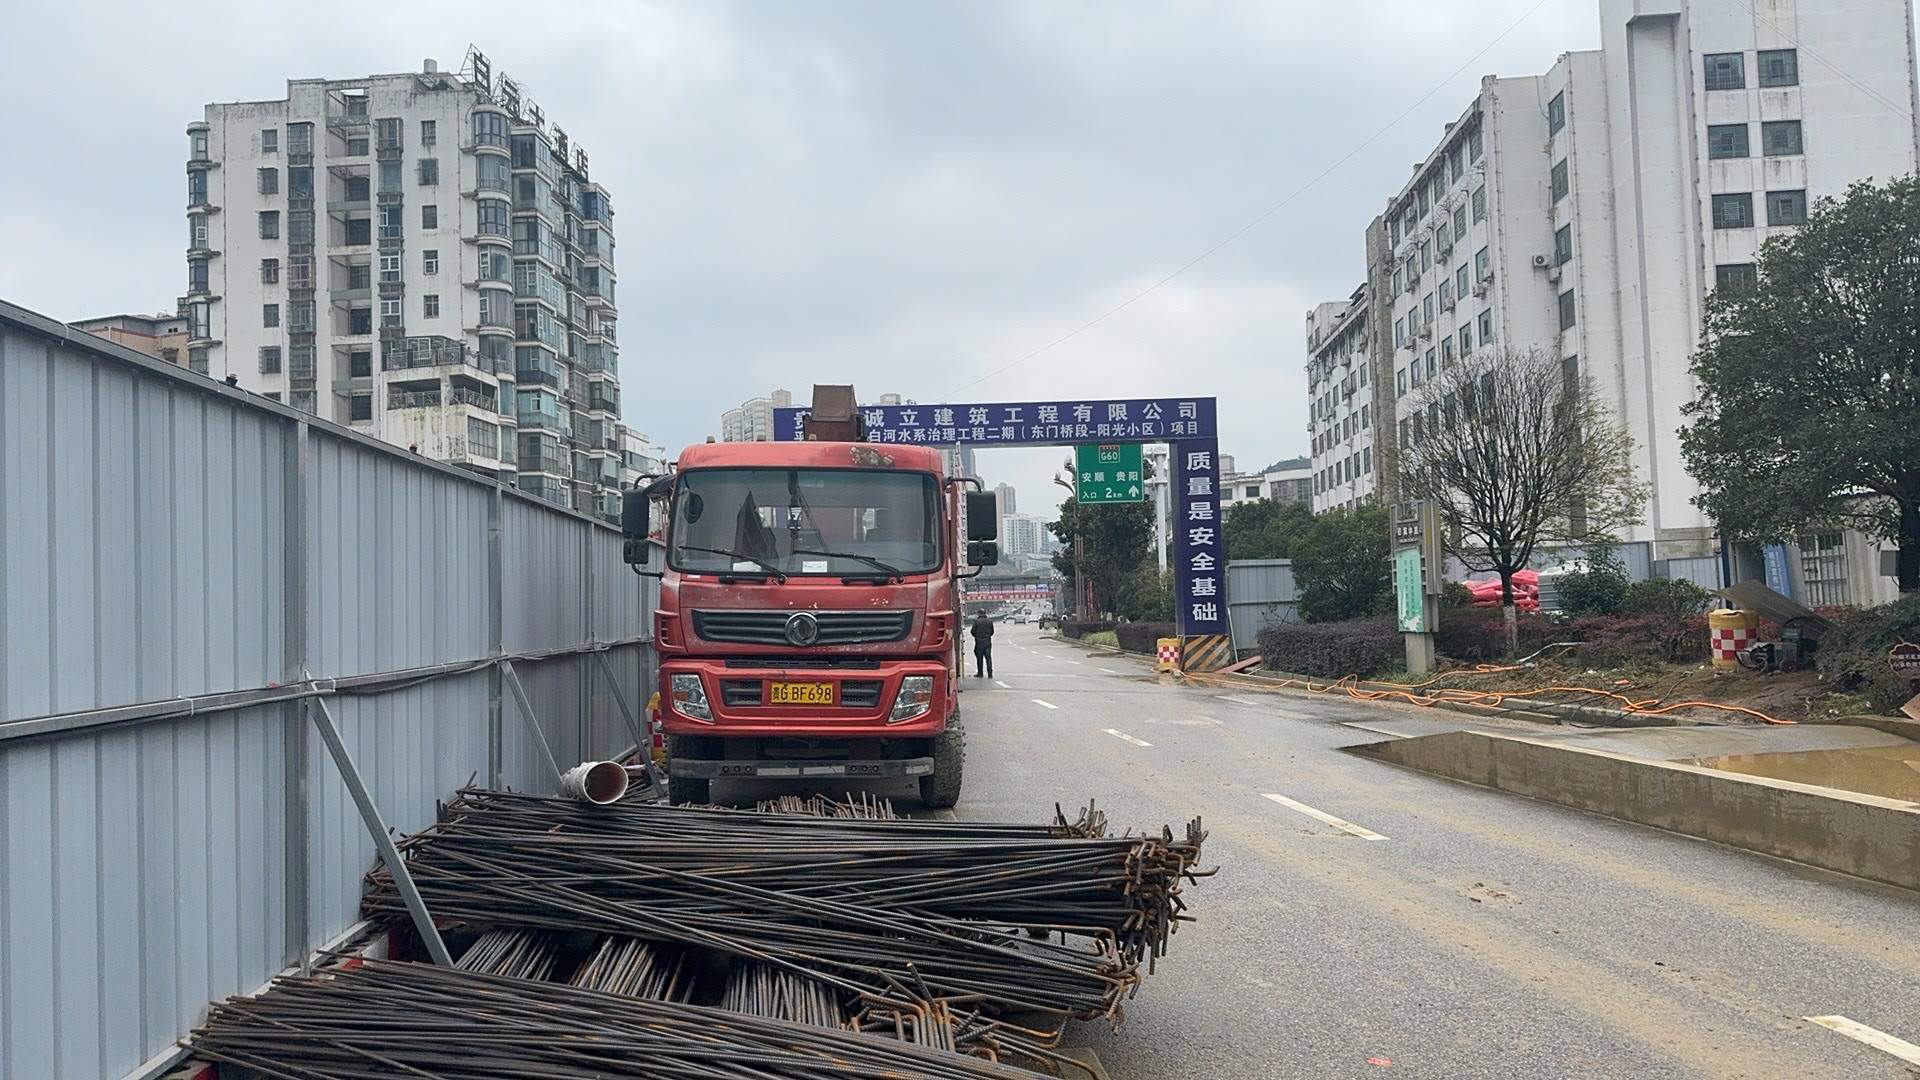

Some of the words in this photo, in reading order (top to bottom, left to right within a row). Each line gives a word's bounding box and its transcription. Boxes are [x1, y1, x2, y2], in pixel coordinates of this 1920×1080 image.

[794, 402, 1198, 430] 贵诚立建筑工程有限公司
[1101, 451, 1118, 461] G60
[1081, 471, 1105, 483] 安顺
[1116, 471, 1138, 482] 贵阳
[1082, 491, 1097, 499] 入口
[1186, 451, 1218, 621] 质量是安全基础
